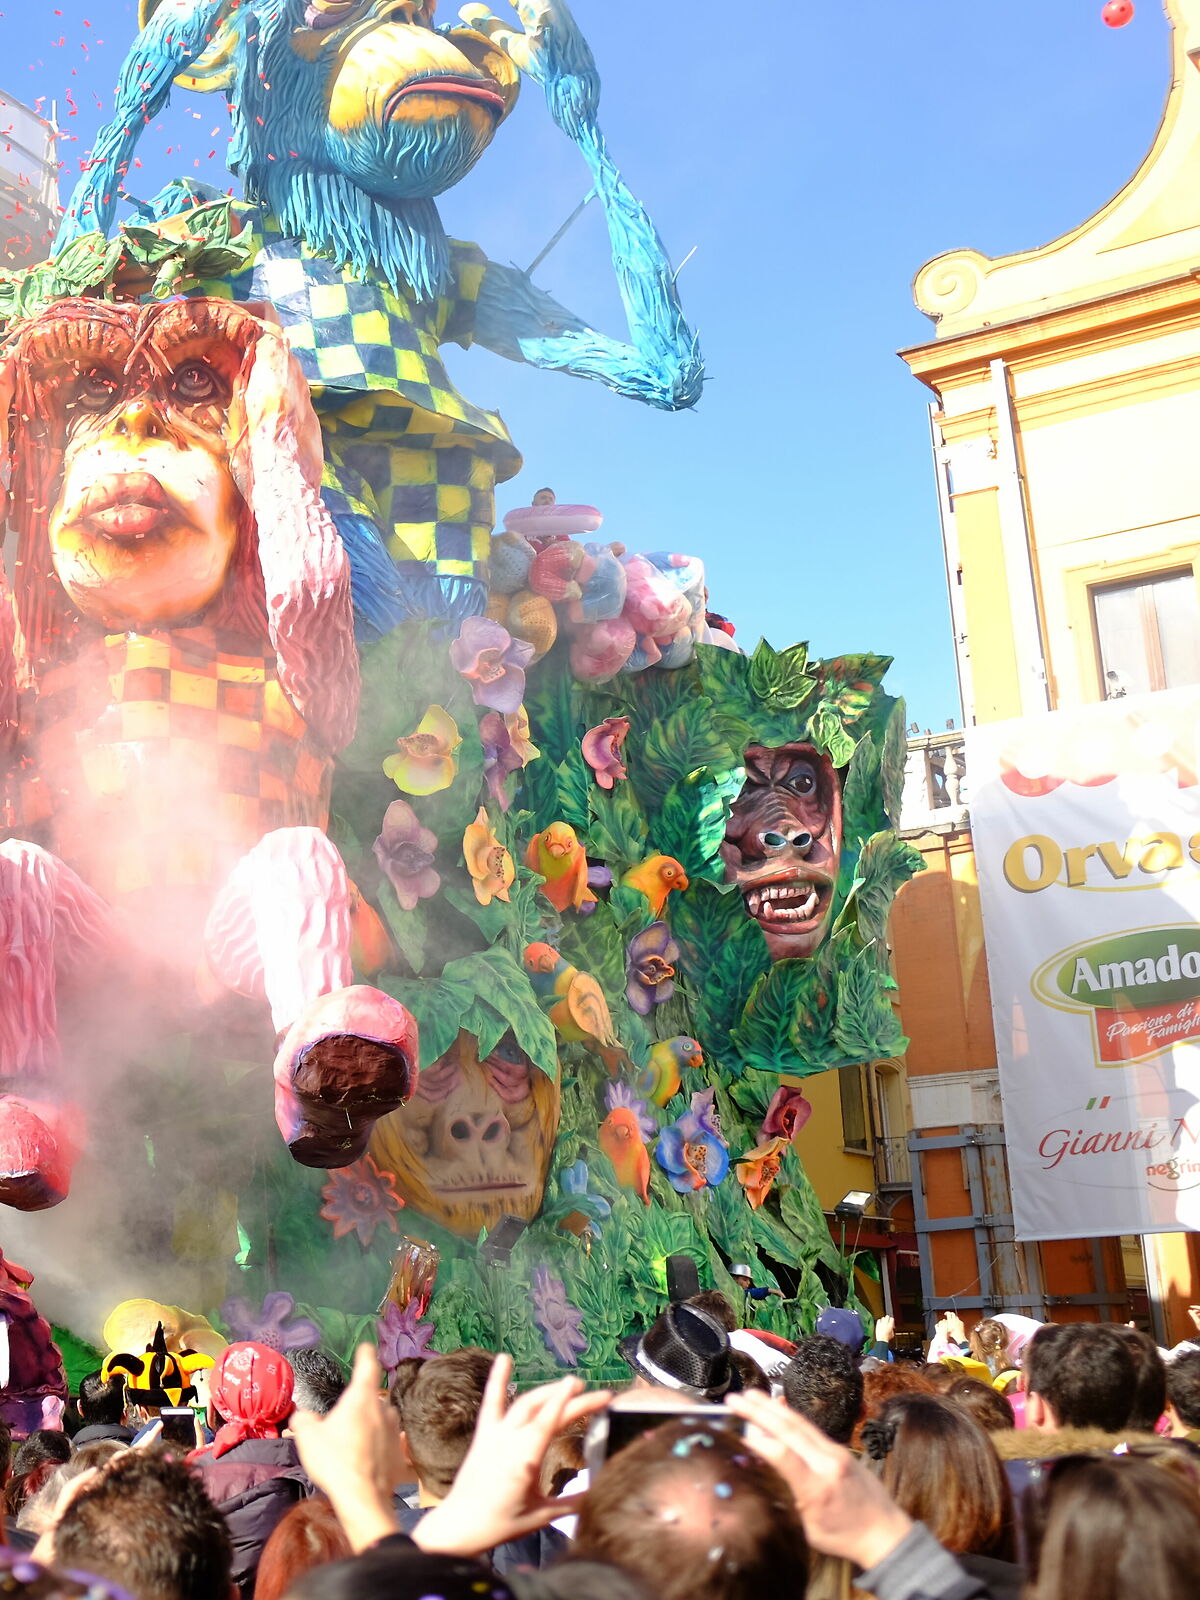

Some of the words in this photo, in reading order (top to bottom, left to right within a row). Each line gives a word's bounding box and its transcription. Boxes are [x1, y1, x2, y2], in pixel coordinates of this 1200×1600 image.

[1106, 1012, 1173, 1042] Passione
[1176, 1002, 1195, 1019] di
[1038, 1120, 1165, 1169] Gianni
